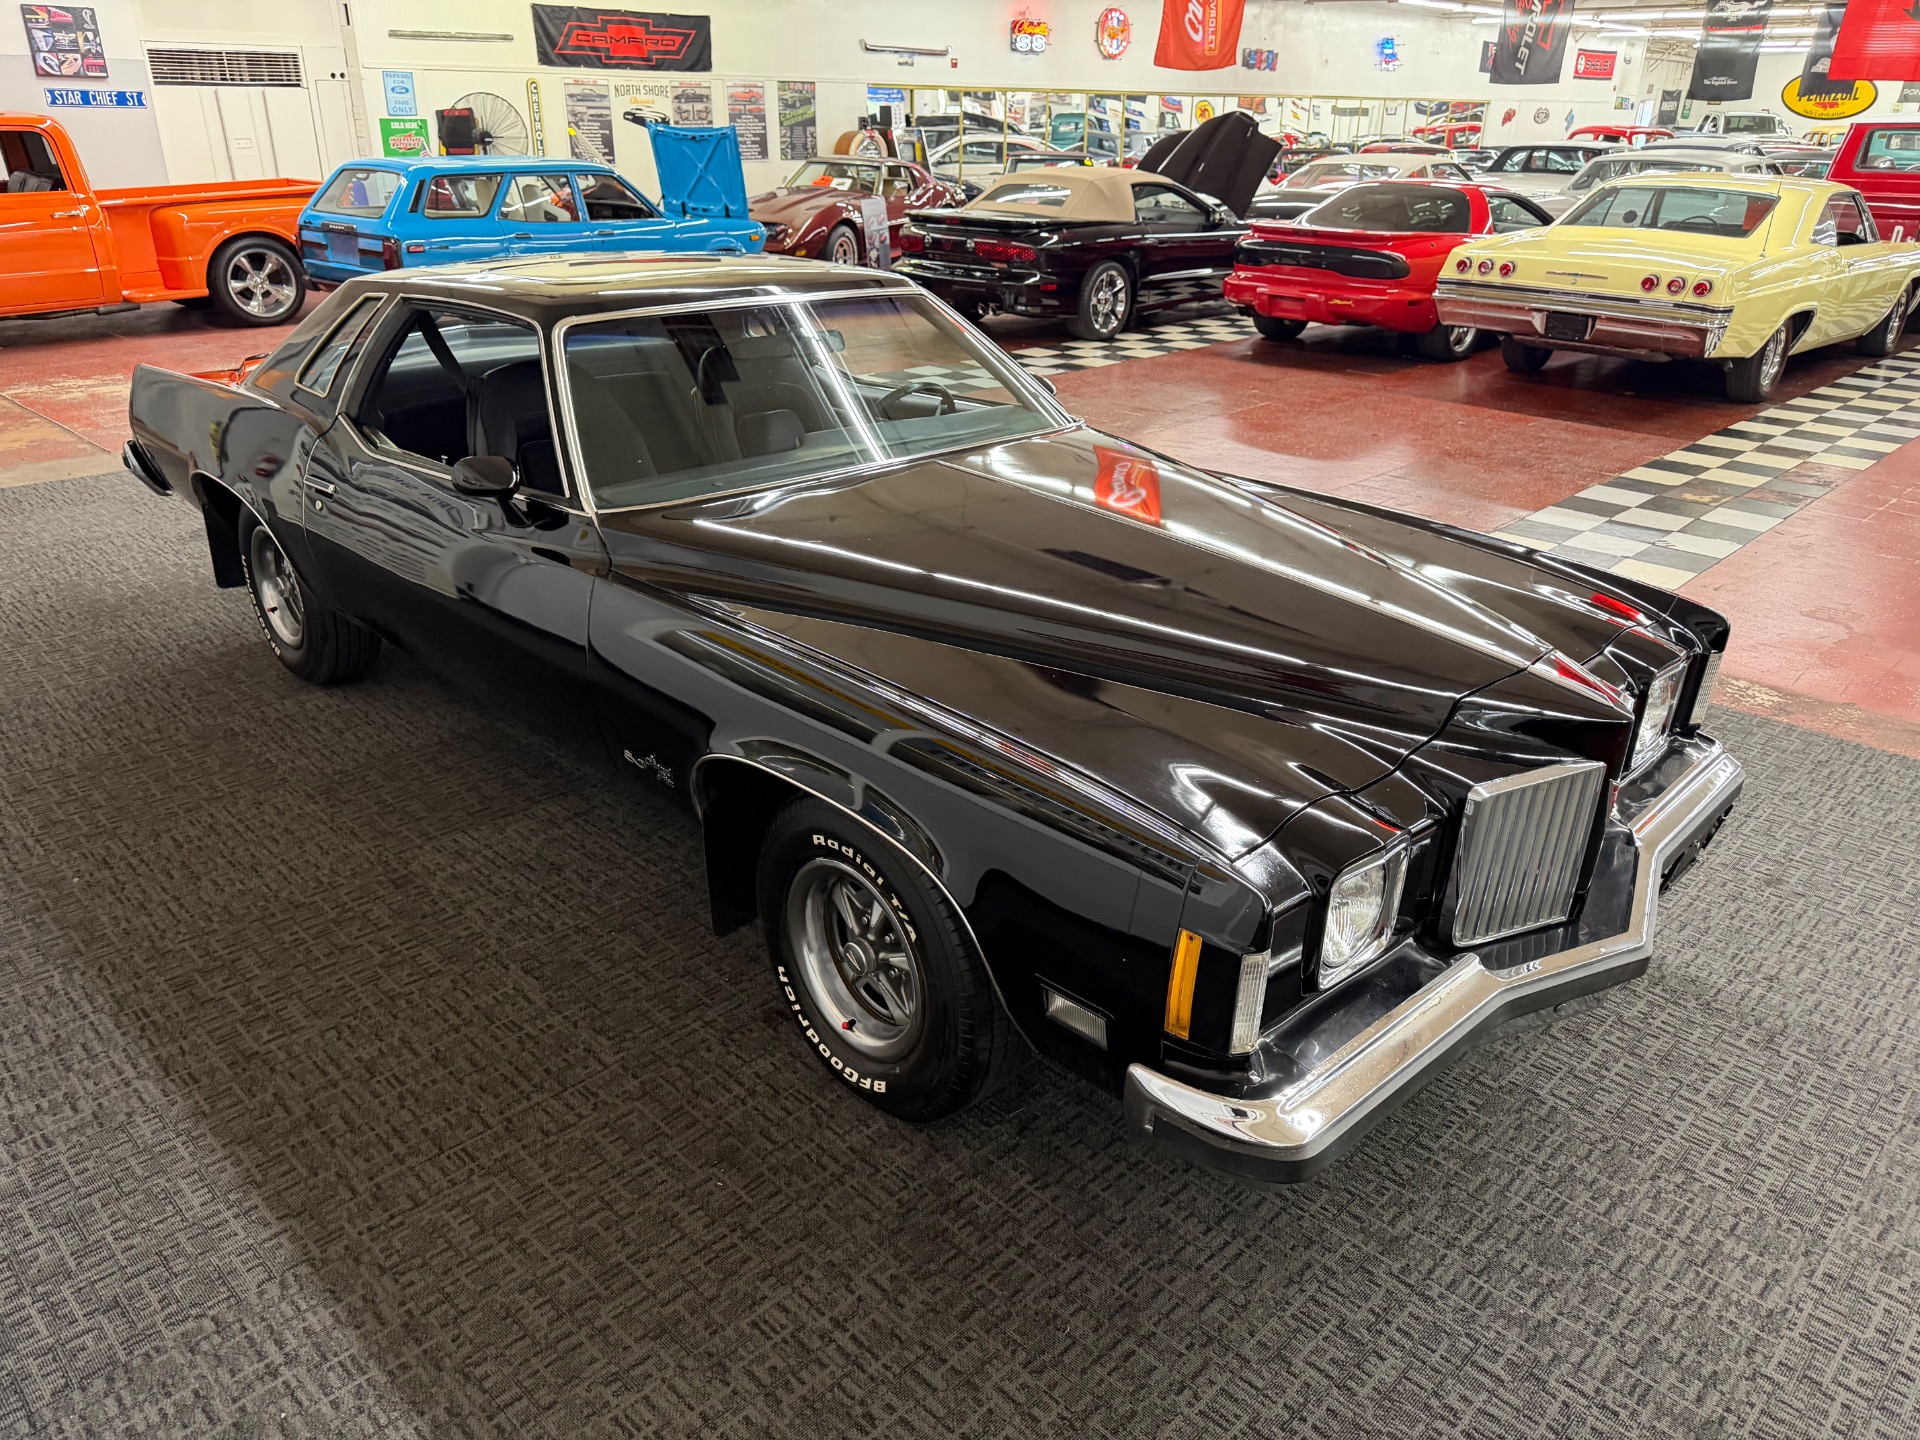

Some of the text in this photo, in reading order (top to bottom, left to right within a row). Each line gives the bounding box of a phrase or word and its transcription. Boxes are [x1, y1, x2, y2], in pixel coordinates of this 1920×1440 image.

[576, 33, 676, 47] CAMARO
[1016, 34, 1046, 51] SS
[1585, 59, 1613, 72] SHELBY
[54, 90, 139, 106] STAR CHIEF ST
[614, 85, 671, 98] NORTH SHORE
[629, 96, 655, 105] Classics
[1814, 110, 1846, 118] Lubrication
[812, 834, 917, 943] Radial T/A
[777, 965, 887, 1093] BFGoodrich
